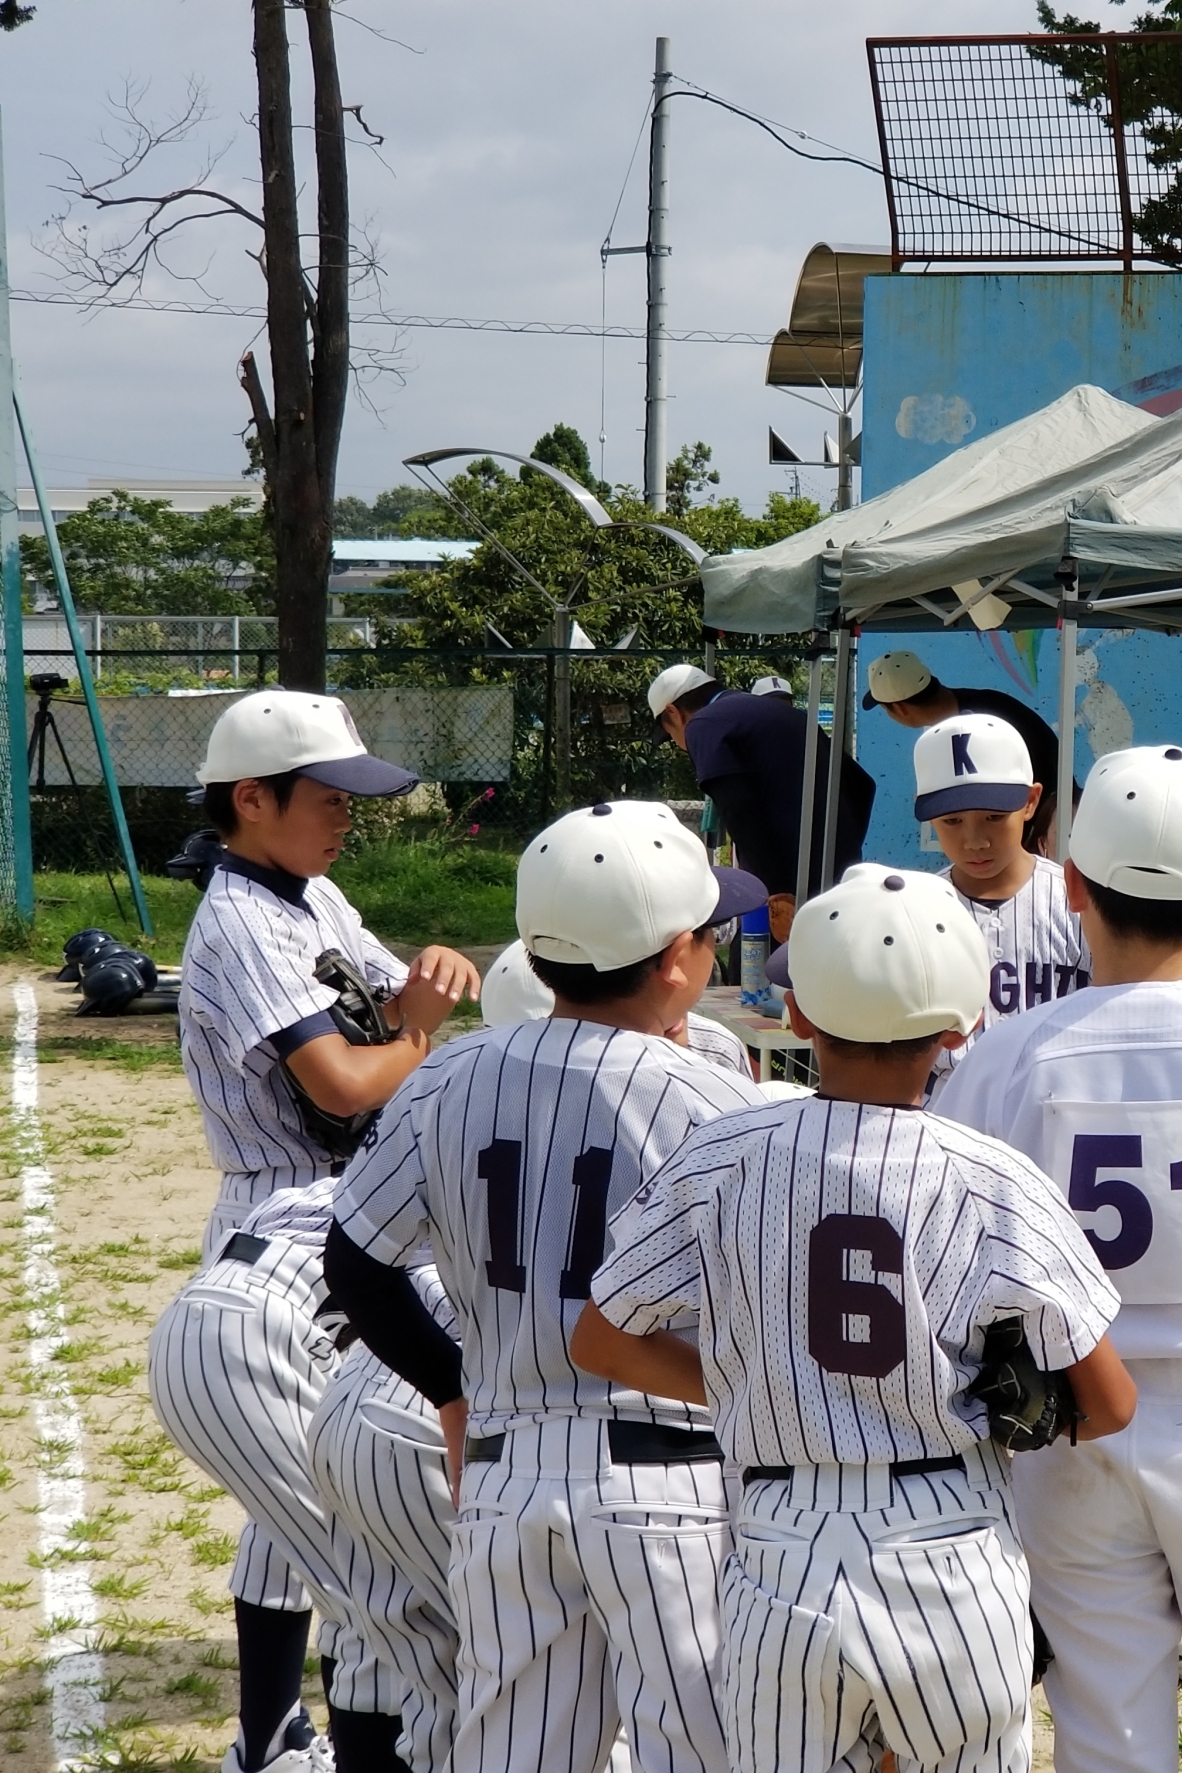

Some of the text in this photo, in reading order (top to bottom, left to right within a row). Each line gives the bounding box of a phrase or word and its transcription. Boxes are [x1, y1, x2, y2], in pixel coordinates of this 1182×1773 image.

[951, 732, 979, 776] K
[477, 1138, 614, 1300] 11
[807, 1213, 908, 1379] 6
